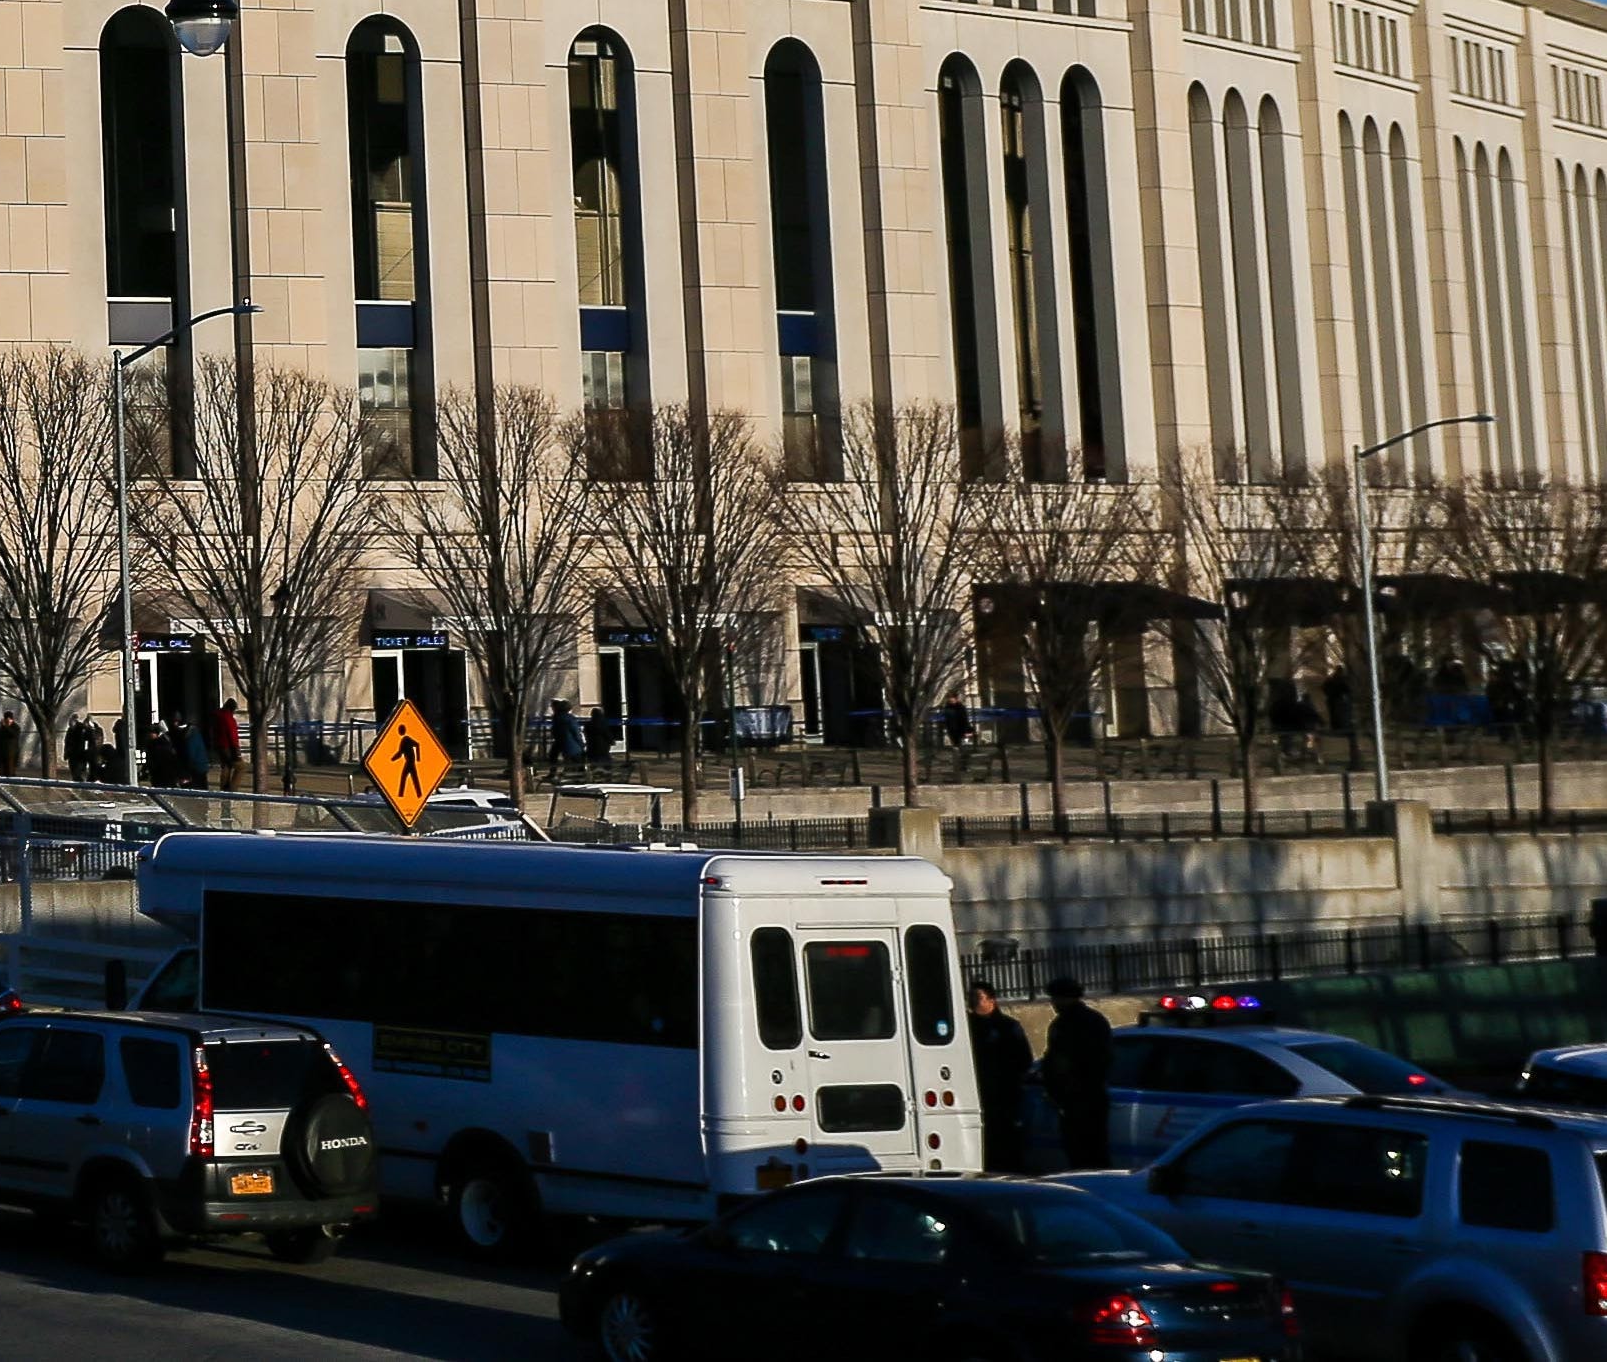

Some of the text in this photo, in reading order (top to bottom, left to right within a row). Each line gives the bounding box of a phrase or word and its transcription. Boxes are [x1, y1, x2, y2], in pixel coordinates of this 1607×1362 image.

[374, 636, 446, 646] TICKET SALES
[321, 1136, 368, 1151] HONDA
